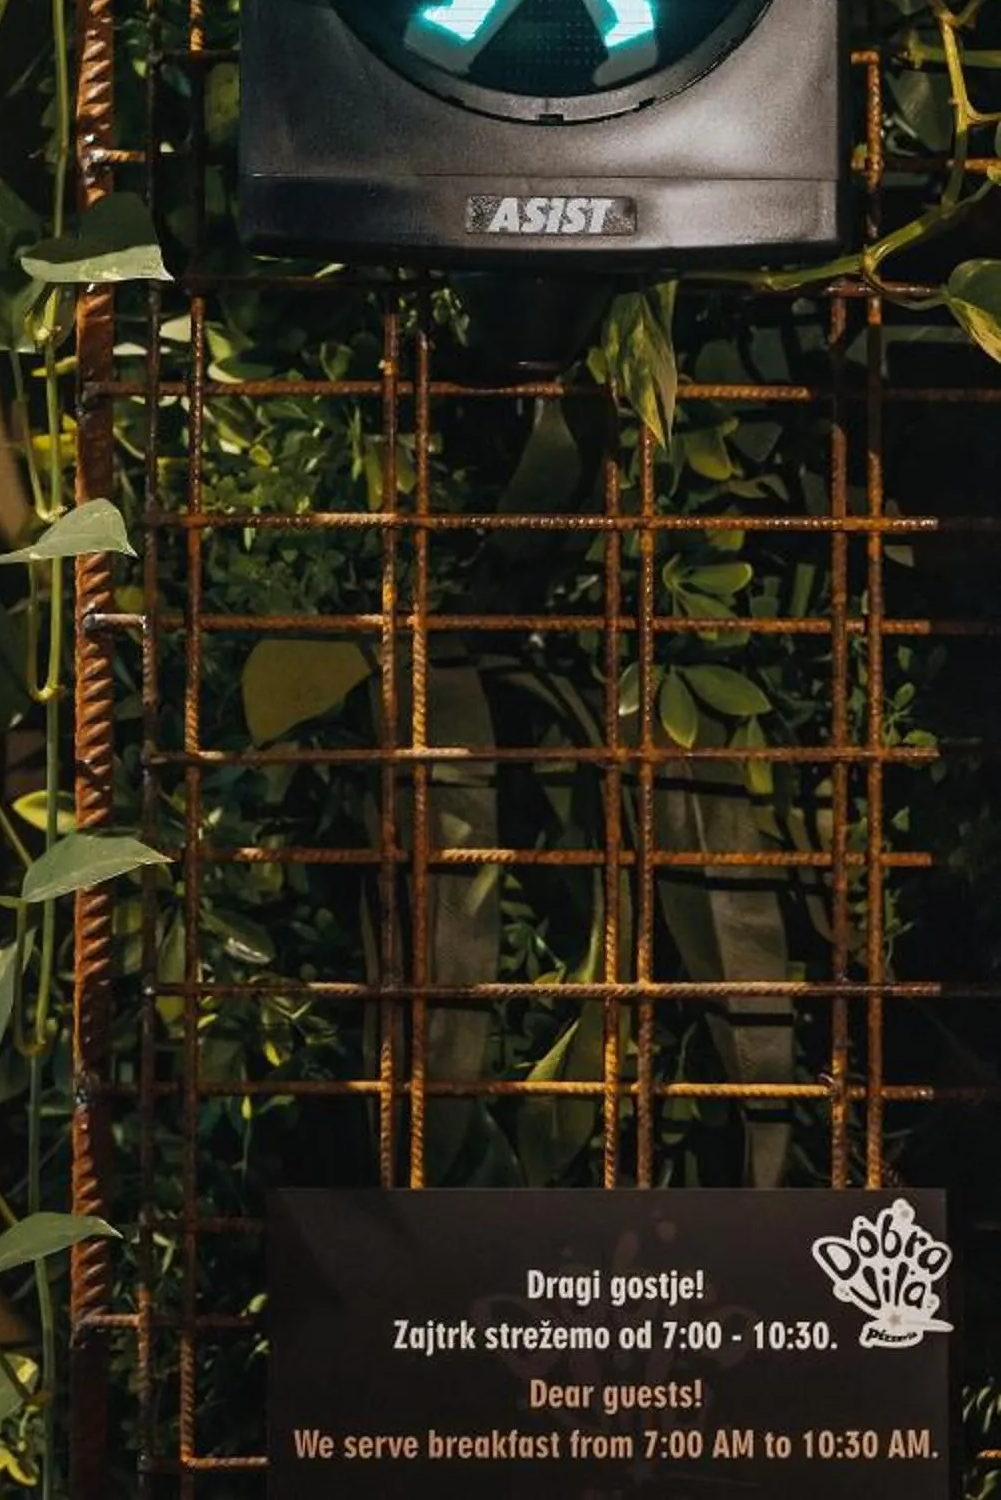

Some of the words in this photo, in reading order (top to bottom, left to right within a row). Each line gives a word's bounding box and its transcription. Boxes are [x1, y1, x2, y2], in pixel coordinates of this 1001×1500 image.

[488, 197, 615, 233] ASIST
[819, 1214, 948, 1280] Dobra
[527, 1269, 600, 1307] Dragi
[610, 1269, 704, 1307] gostje!
[849, 1261, 927, 1310] Vila
[393, 1319, 476, 1357] Zajtrk
[484, 1319, 610, 1350] strežemo
[618, 1320, 652, 1350] od
[662, 1321, 722, 1350] 7:00
[753, 1321, 838, 1350] 10:30.
[529, 1379, 594, 1409] Dear
[603, 1379, 702, 1415] guests!
[294, 1430, 334, 1459] We
[344, 1436, 418, 1459] serve
[428, 1430, 560, 1459] breakfast
[570, 1430, 633, 1459] from
[644, 1430, 703, 1459] 7:00
[712, 1430, 754, 1459] AM
[764, 1432, 792, 1459] to
[803, 1430, 878, 1459] 10:30
[888, 1430, 939, 1459] AM.
